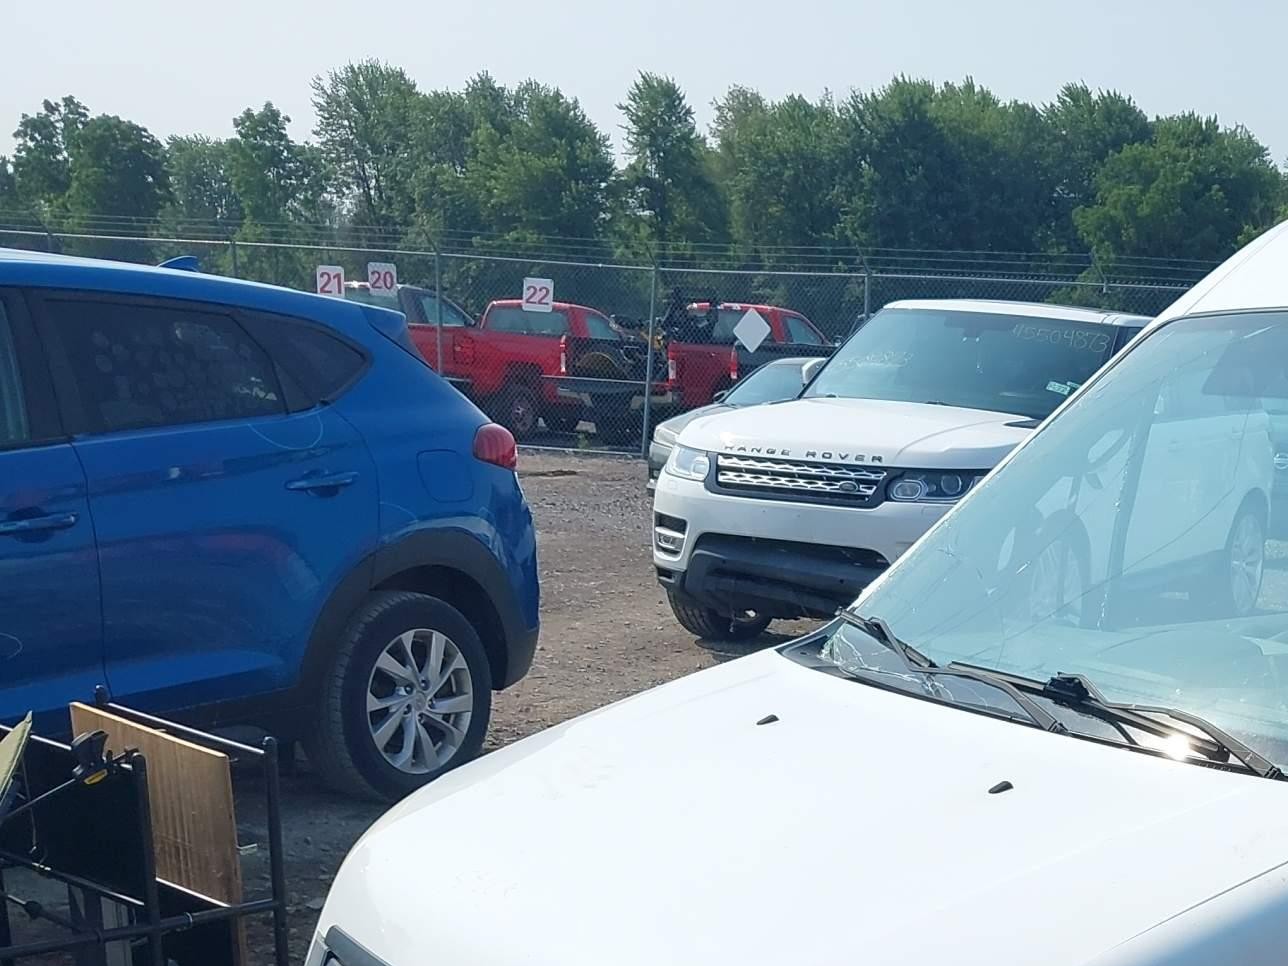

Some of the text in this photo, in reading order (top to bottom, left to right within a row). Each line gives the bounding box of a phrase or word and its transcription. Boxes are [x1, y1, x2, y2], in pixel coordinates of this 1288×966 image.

[319, 272, 342, 294] 21
[370, 270, 394, 290] 20
[526, 285, 550, 306] 22
[724, 445, 884, 463] RANGE ROVER
